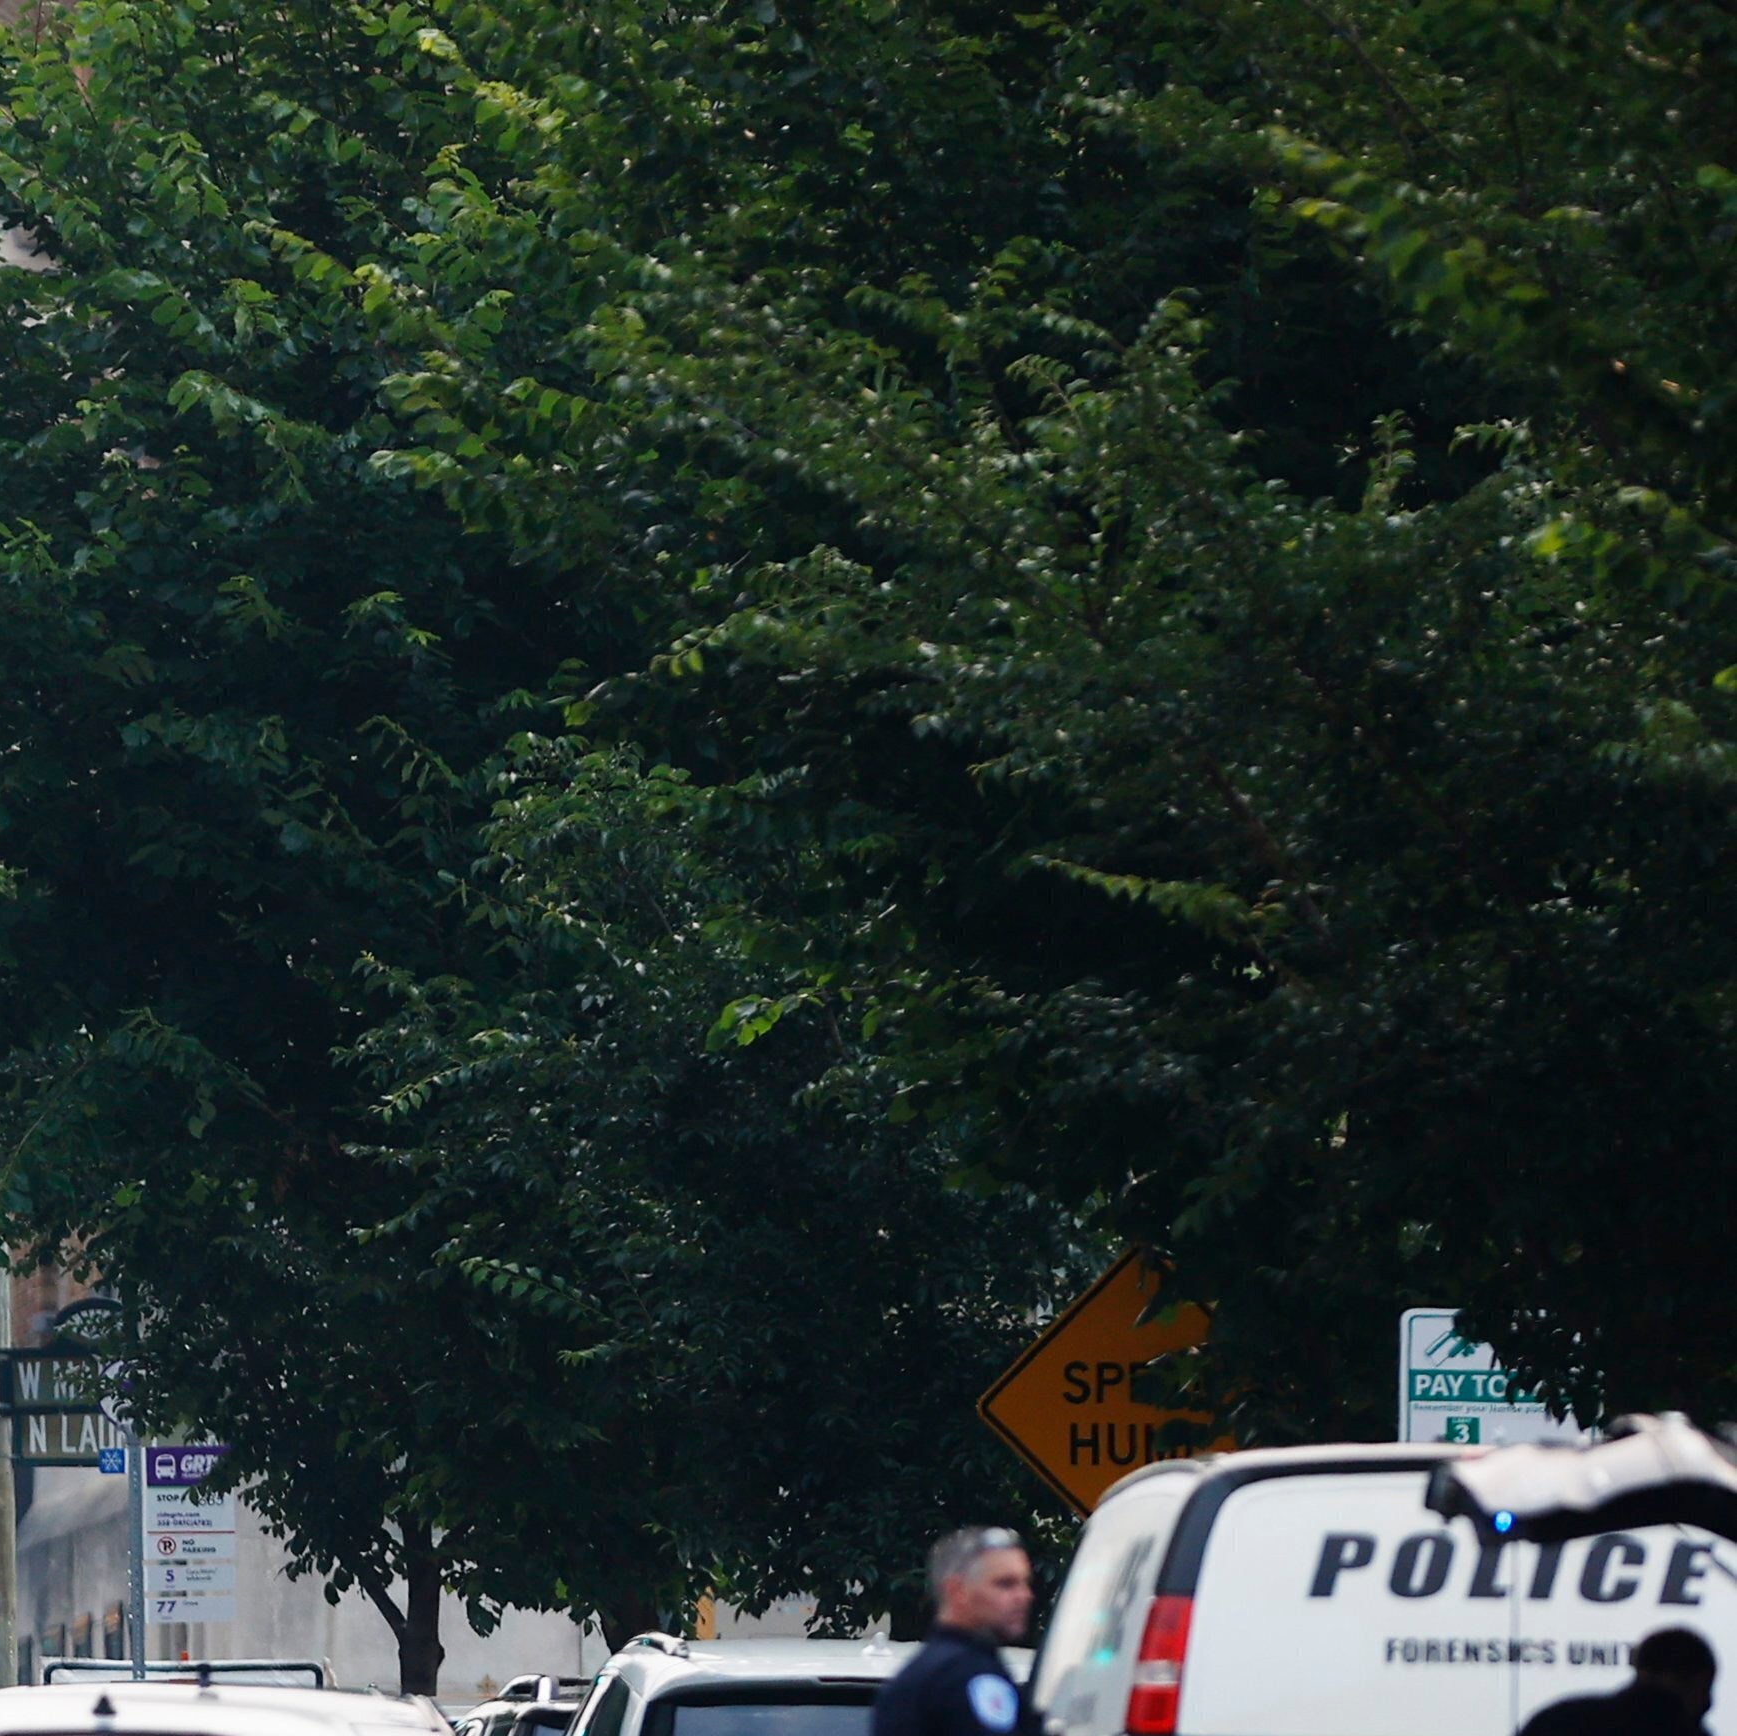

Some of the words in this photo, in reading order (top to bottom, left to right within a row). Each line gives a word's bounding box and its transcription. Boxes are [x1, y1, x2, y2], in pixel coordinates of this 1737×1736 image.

[18, 1361, 41, 1400] W
[1415, 1374, 1465, 1397] PAY
[1471, 1374, 1508, 1398] TO
[29, 1414, 47, 1454] N
[1452, 1424, 1470, 1444] 3
[180, 1454, 219, 1473] GRT
[156, 1494, 180, 1502] STOP
[165, 1569, 175, 1583] 5
[1308, 1532, 1715, 1605] POLICE
[156, 1600, 177, 1613] 77
[1385, 1637, 1557, 1665] FORENSICS
[1568, 1639, 1635, 1666] UNIT
